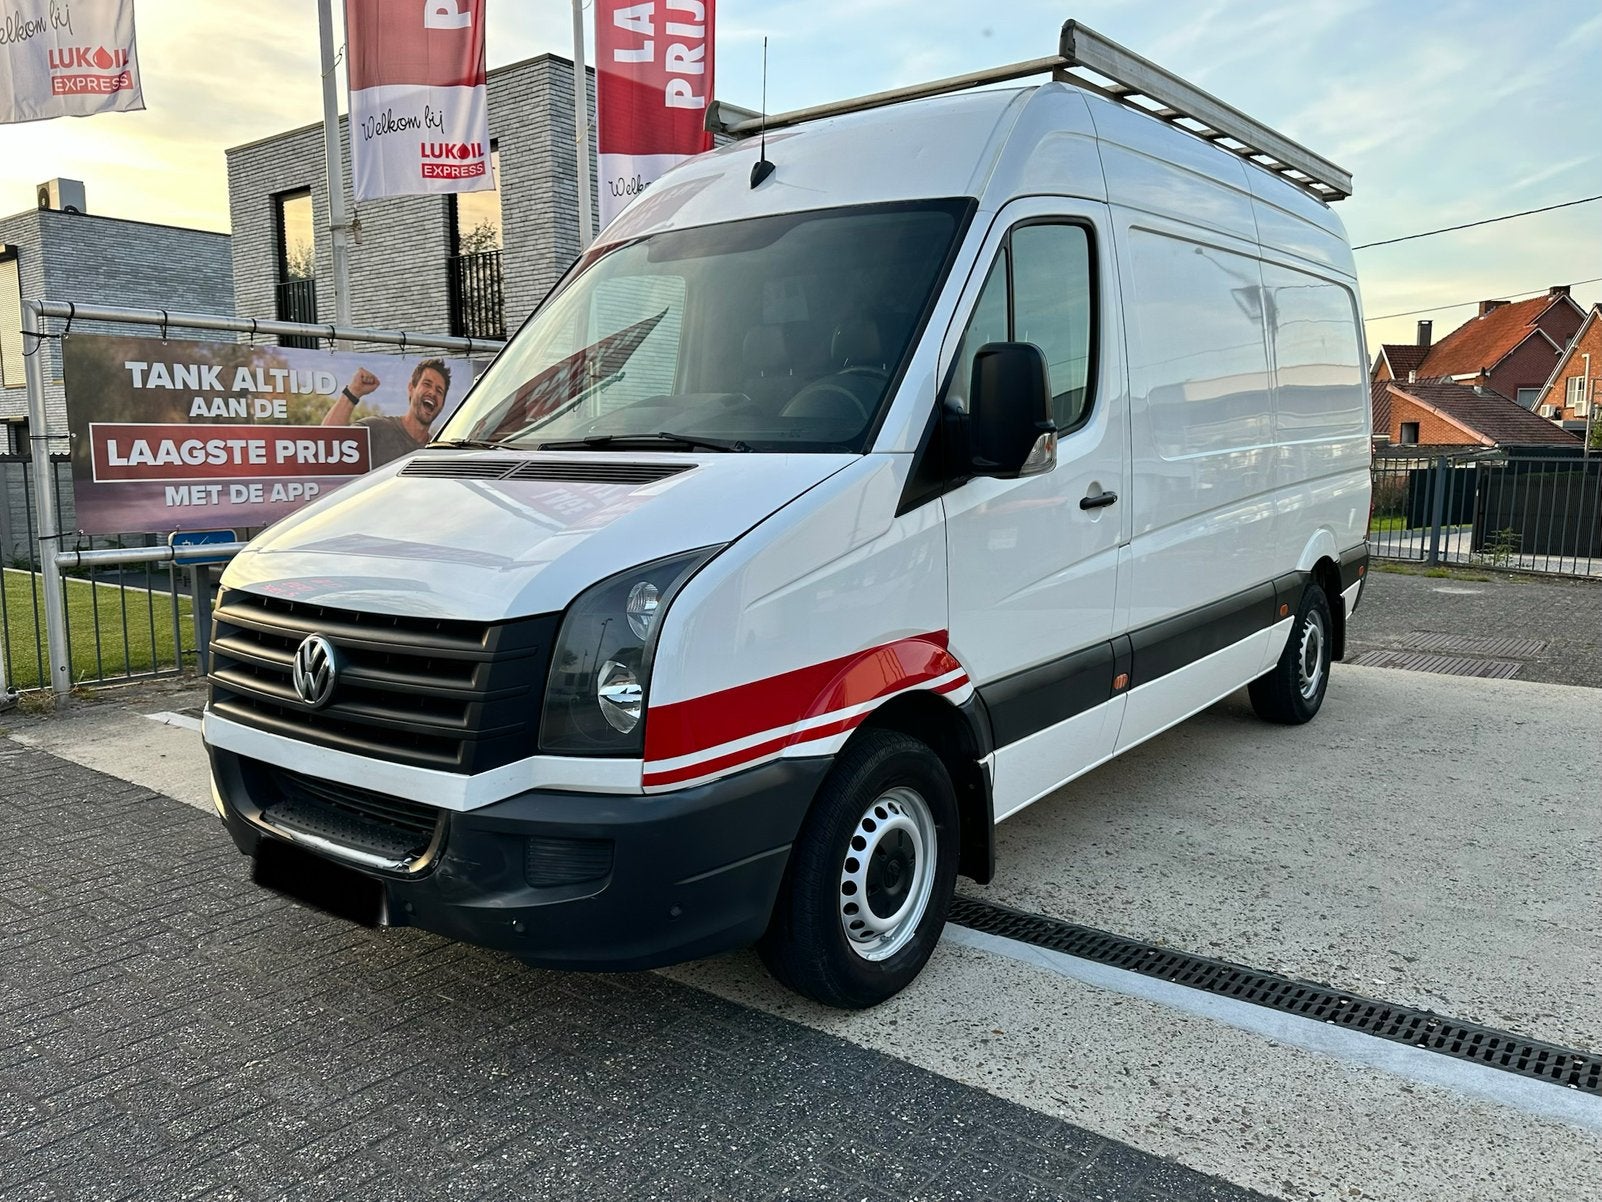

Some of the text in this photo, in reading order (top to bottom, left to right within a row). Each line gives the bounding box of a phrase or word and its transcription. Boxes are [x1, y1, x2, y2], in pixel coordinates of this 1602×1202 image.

[0, 0, 73, 45] elkom bij
[48, 45, 129, 70] LUKOIL
[665, 0, 706, 110] PRIJ
[54, 74, 129, 92] EXPRESS
[361, 105, 445, 141] Welkom bij
[420, 142, 485, 160] LUKOIL
[424, 163, 484, 177] EXPRESS
[607, 174, 652, 197] Welk
[124, 361, 337, 395] TANK ALTIJD
[189, 397, 287, 419] AAN DE
[106, 439, 360, 466] LAAGSTE PRIJS
[164, 482, 320, 506] MET DE APP
[293, 632, 335, 707] VW
